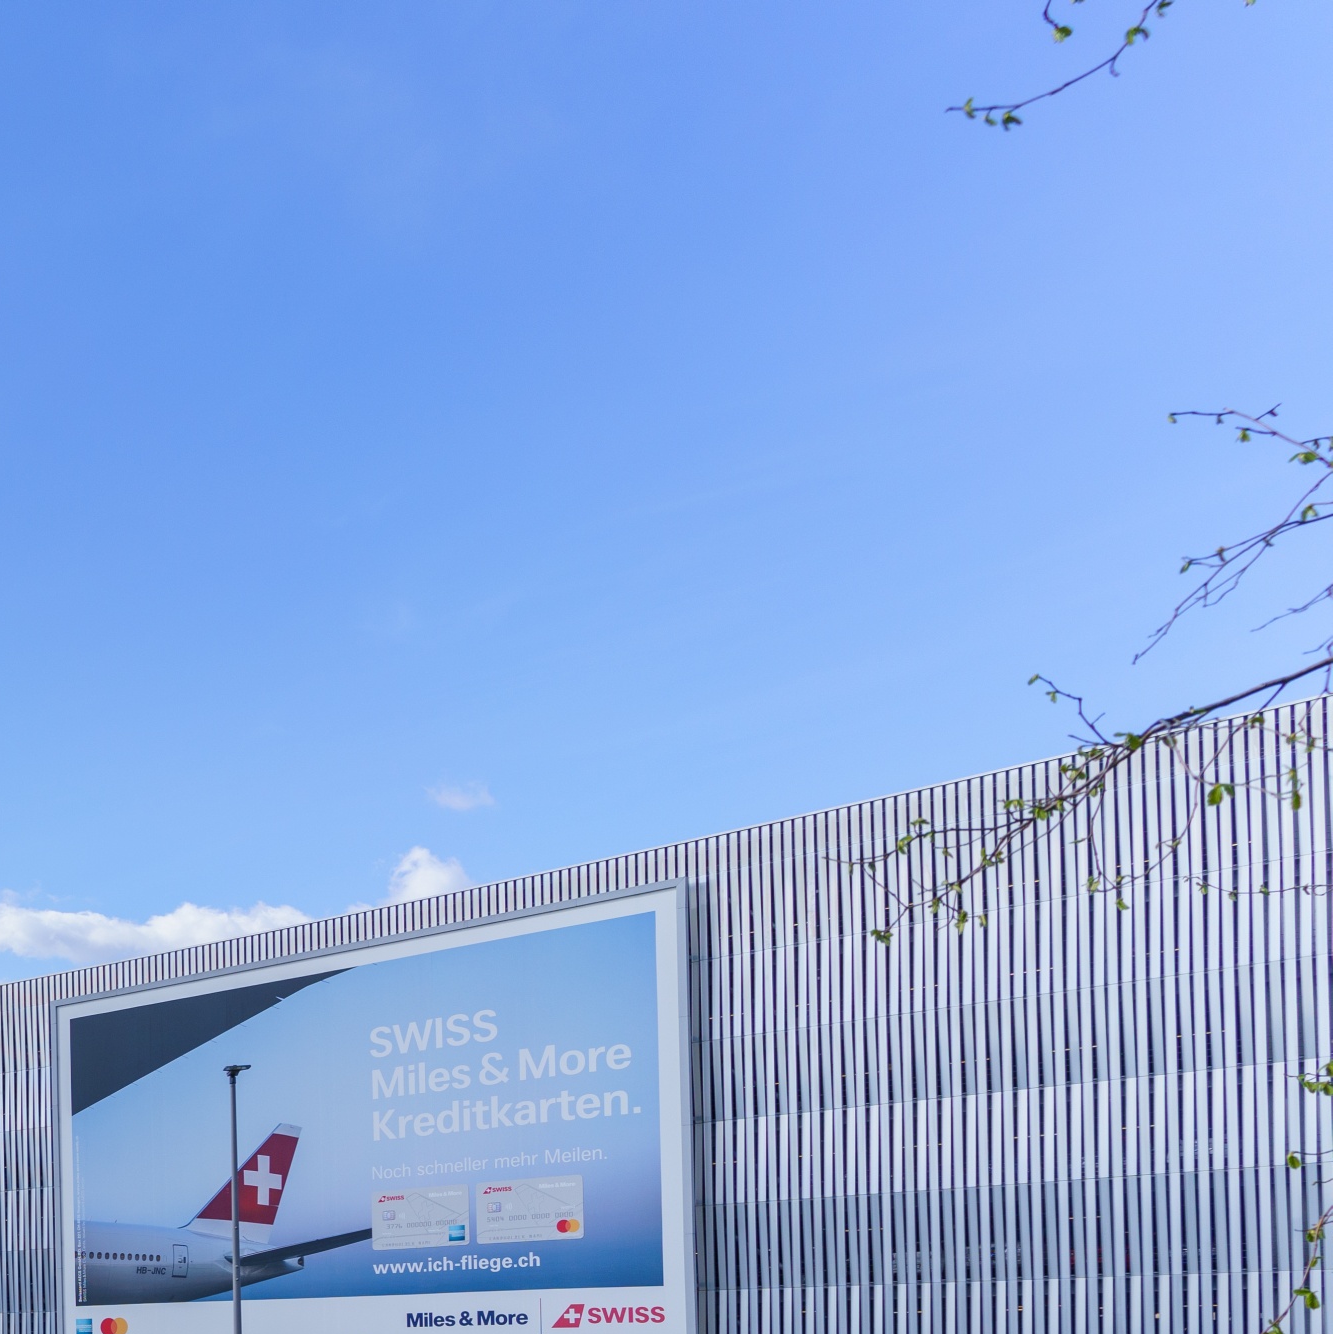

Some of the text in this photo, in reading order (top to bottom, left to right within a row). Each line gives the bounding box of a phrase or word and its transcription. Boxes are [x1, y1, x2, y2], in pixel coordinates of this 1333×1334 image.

[369, 1009, 498, 1058] SWISS
[371, 1043, 632, 1100] Miles & More
[372, 1089, 642, 1142] Kreditkarten.
[372, 1145, 608, 1180] Noch schneller mehr Meilen.
[386, 1194, 405, 1202] SWISS
[136, 1266, 166, 1275] HB-JNC
[373, 1252, 541, 1275] www.ich-fliege.ch
[406, 1310, 529, 1328] Miles & More
[587, 1306, 665, 1324] SWISS
